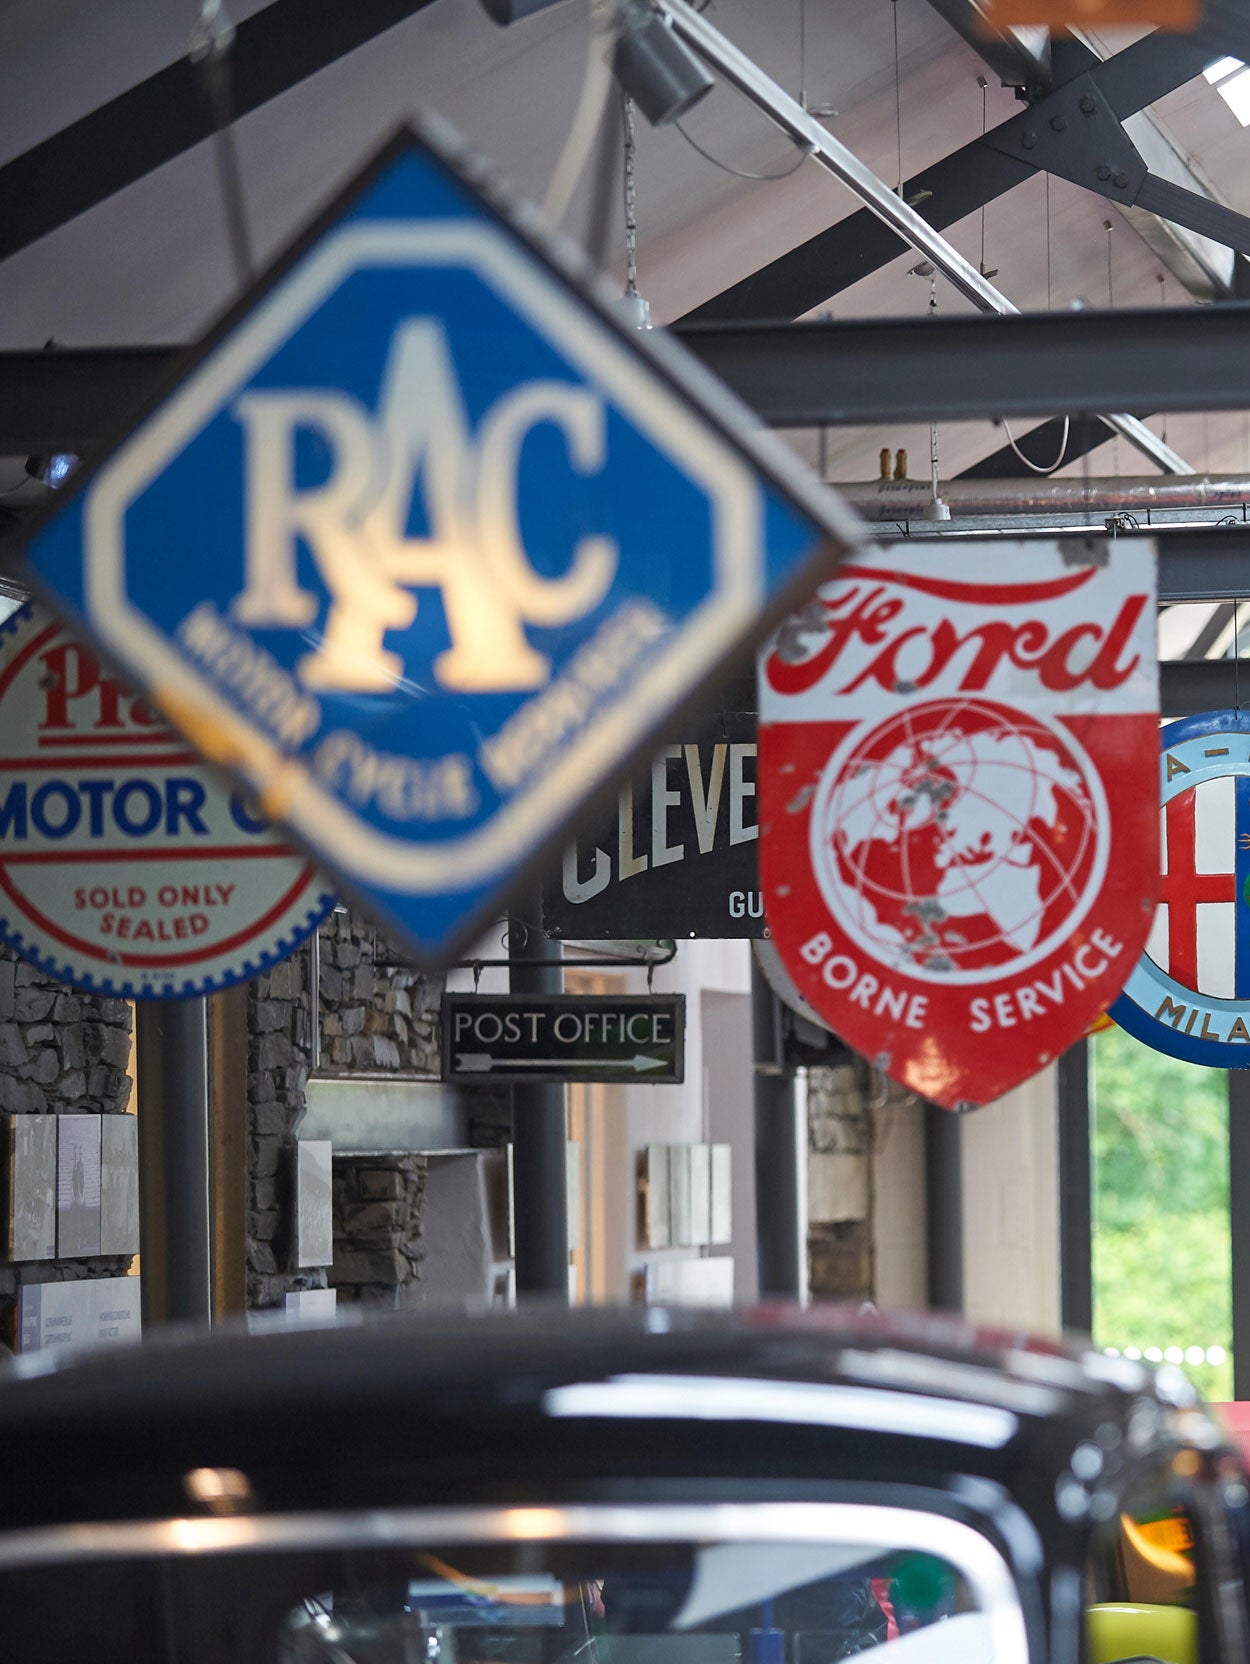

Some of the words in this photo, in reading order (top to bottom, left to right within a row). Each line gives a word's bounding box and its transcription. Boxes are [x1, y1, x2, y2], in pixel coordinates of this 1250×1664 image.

[229, 314, 620, 690] RAC
[766, 564, 1150, 696] Ford
[74, 886, 146, 911] SOLD
[157, 883, 236, 906] ONLY
[100, 912, 209, 942] SEALED
[800, 931, 929, 1030] BORNE
[969, 927, 1124, 1032] SERVICE
[455, 1012, 546, 1043] POST
[553, 1012, 672, 1044] OFFICE
